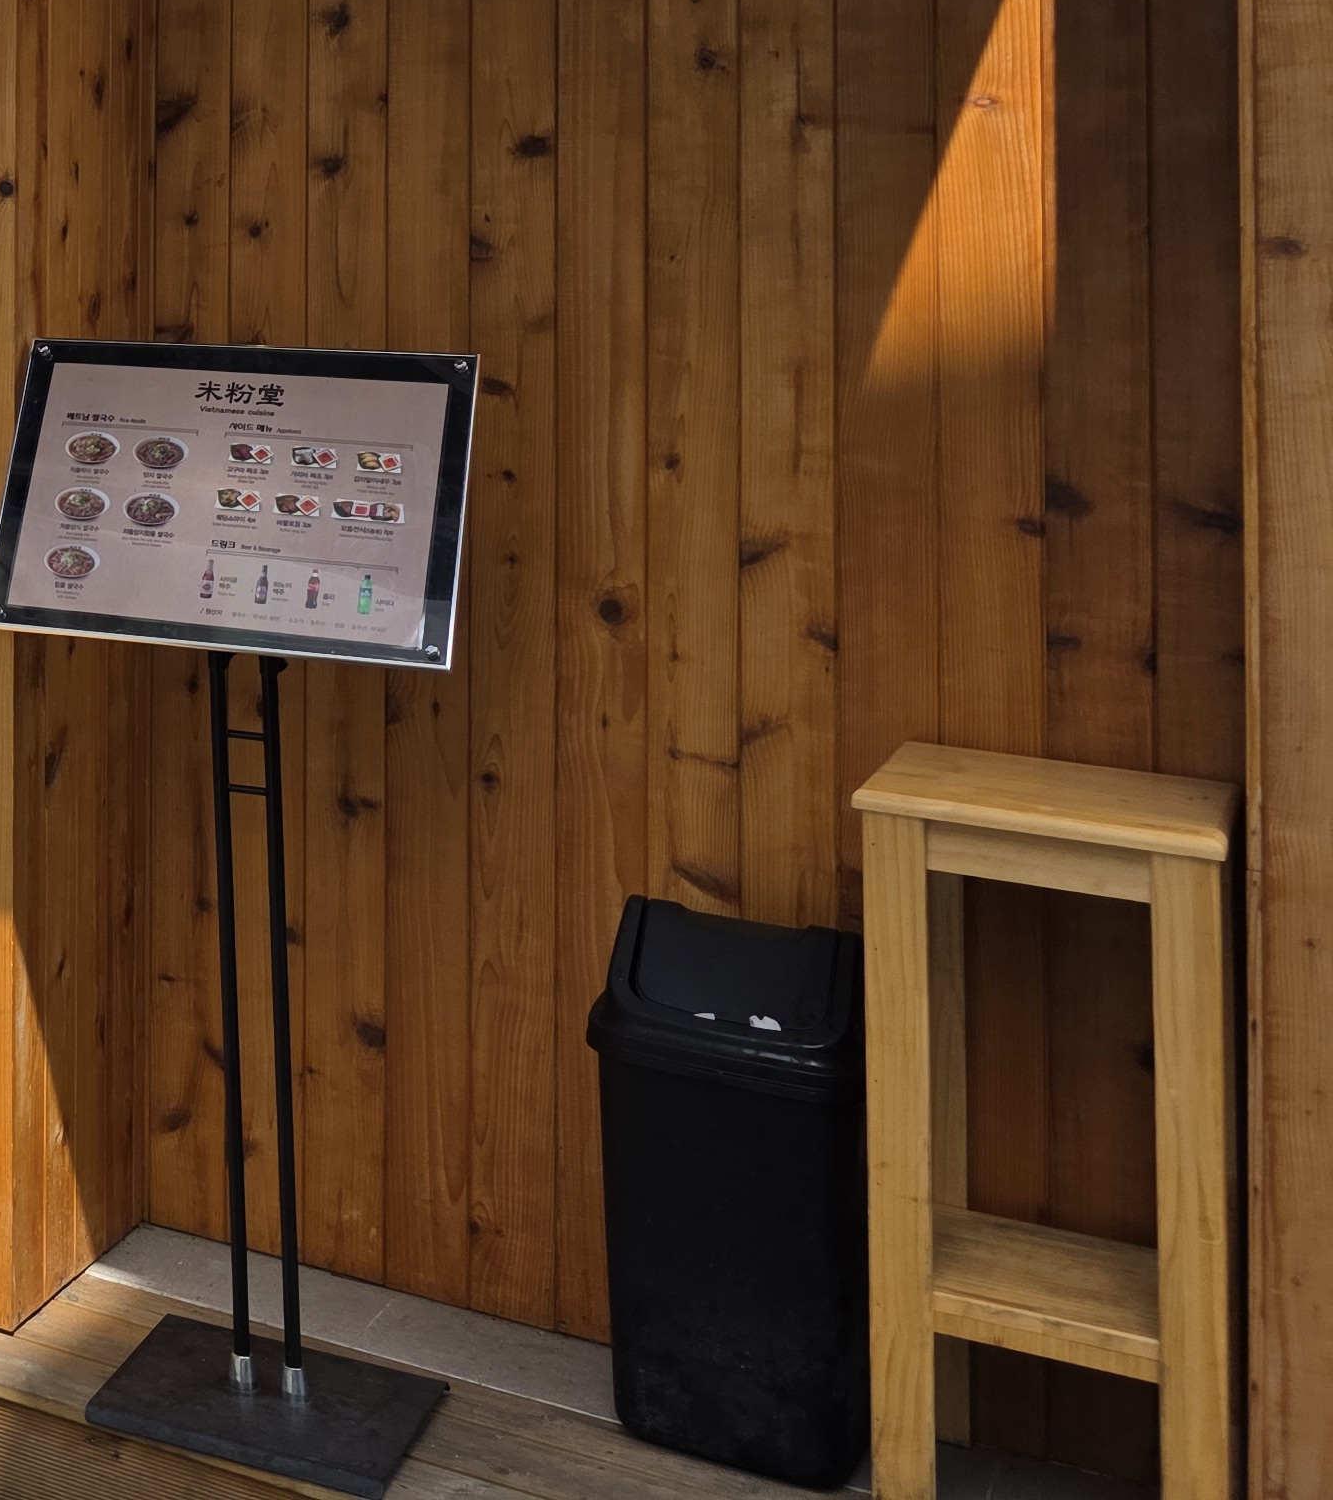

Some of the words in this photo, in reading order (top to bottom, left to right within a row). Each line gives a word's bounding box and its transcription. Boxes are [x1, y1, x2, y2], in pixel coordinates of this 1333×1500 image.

[194, 380, 285, 407] 米粉堂
[200, 405, 245, 415] Vietnamese
[247, 408, 275, 417] cuisine
[66, 412, 91, 422] 베트남
[91, 414, 115, 423] 쌀국수
[229, 422, 254, 432] 사이드
[256, 423, 272, 433] 메뉴
[211, 539, 236, 549] 드링크
